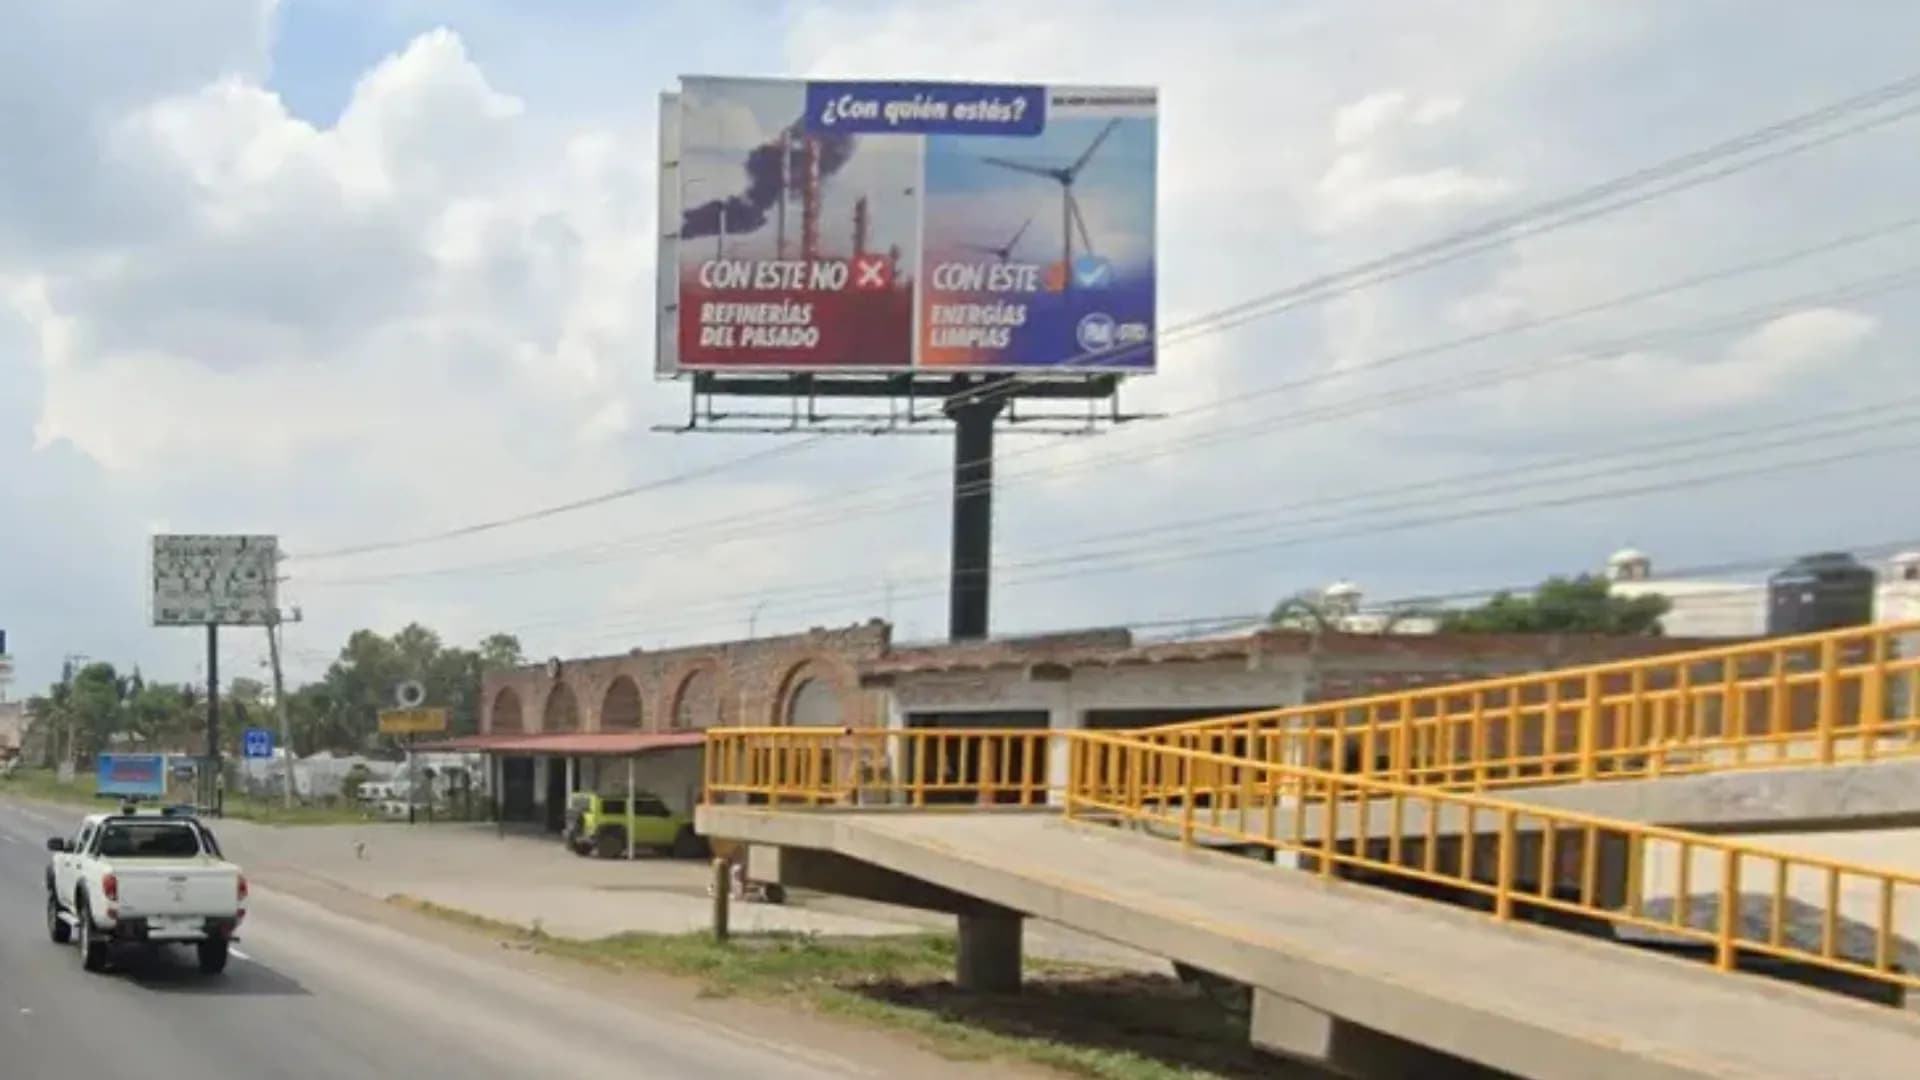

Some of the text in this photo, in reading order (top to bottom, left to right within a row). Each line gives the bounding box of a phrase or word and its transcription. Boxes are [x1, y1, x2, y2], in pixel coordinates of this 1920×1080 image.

[821, 94, 1028, 126] ¿Con quién estás?
[700, 260, 849, 291] CON ESTE NO
[933, 262, 1041, 292] CON ESTE
[701, 299, 814, 325] REFINERÍAS
[931, 300, 1028, 326] ENERGÍAS
[700, 326, 820, 348] DEL PASADO
[930, 326, 1012, 349] LIMPIAS
